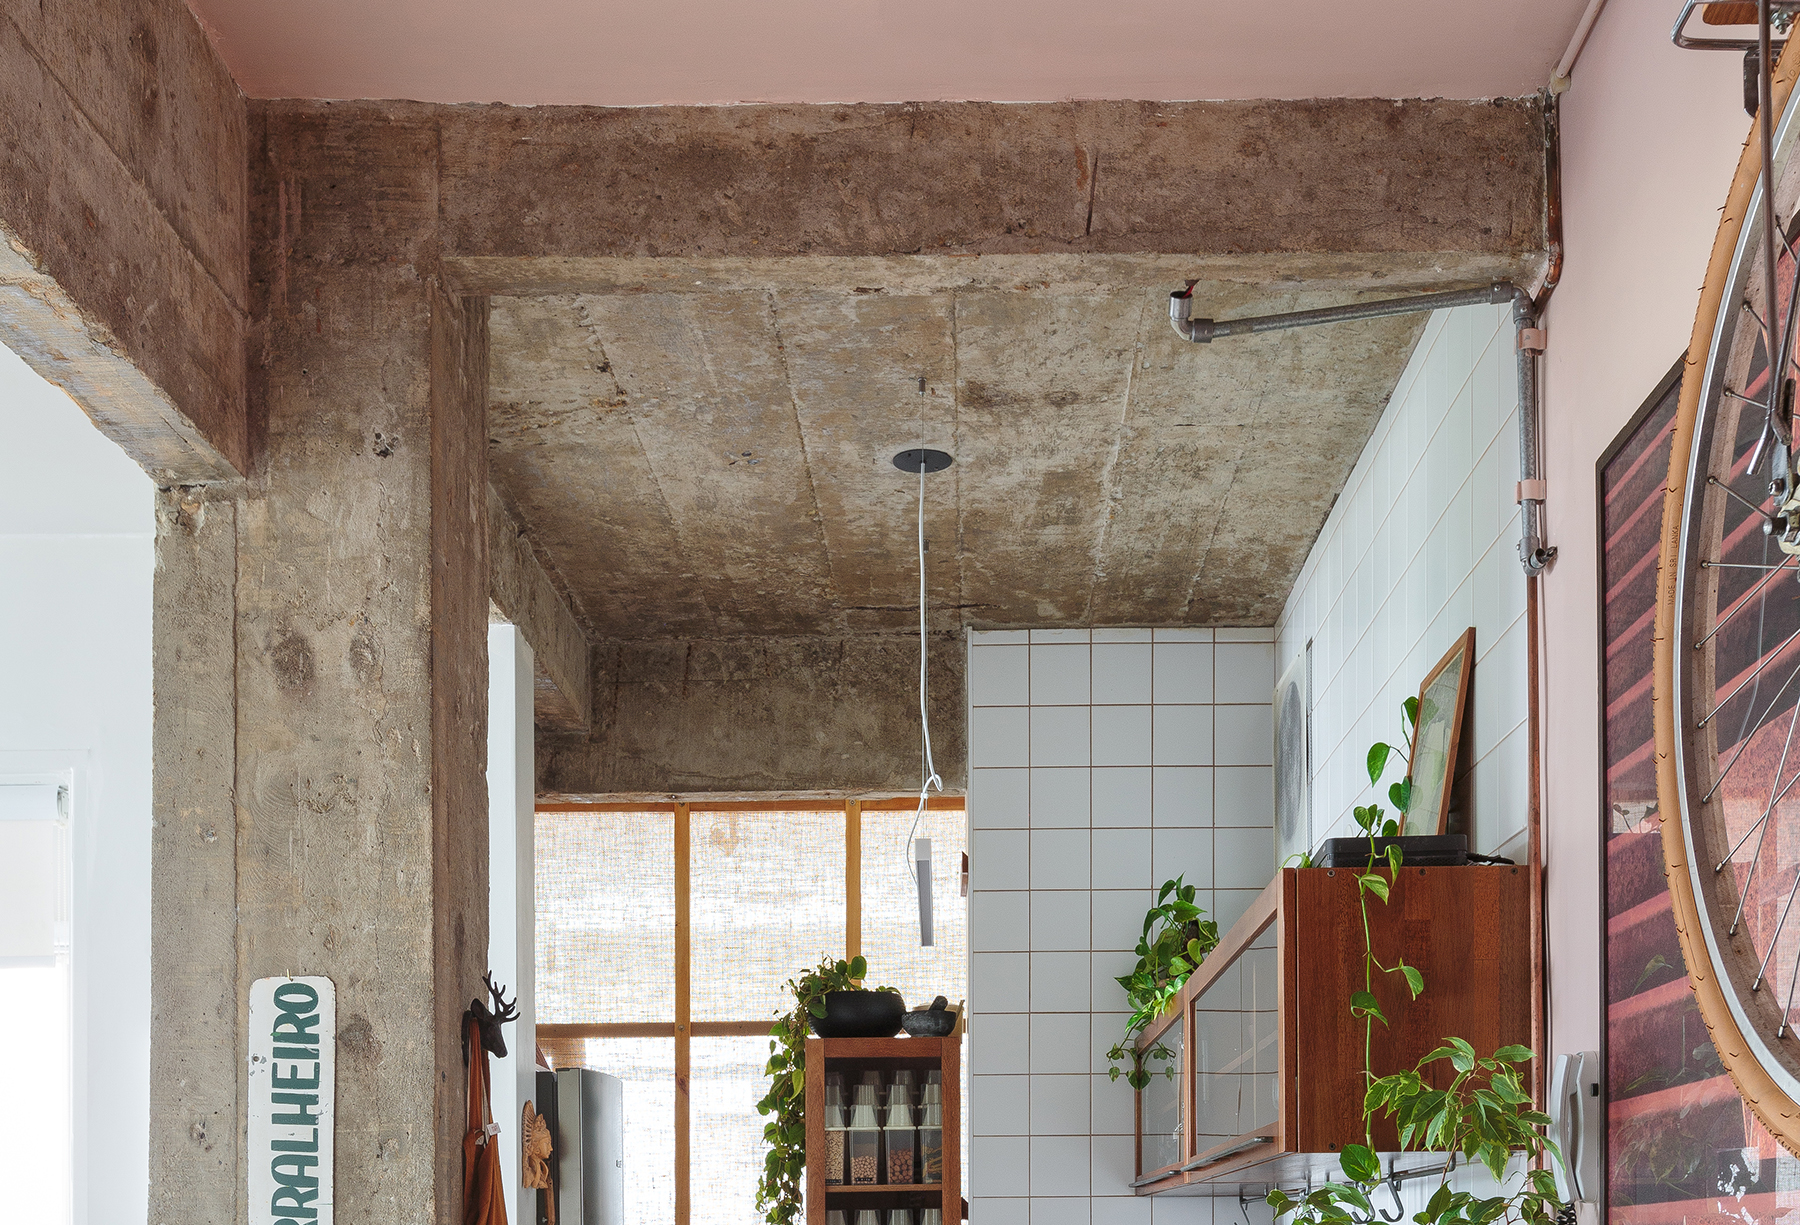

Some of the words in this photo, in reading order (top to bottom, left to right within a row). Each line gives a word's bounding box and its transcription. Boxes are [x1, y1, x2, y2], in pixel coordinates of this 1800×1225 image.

[1670, 525, 1679, 549] LANKA
[1669, 554, 1677, 568] SRI
[1668, 571, 1677, 579] IN
